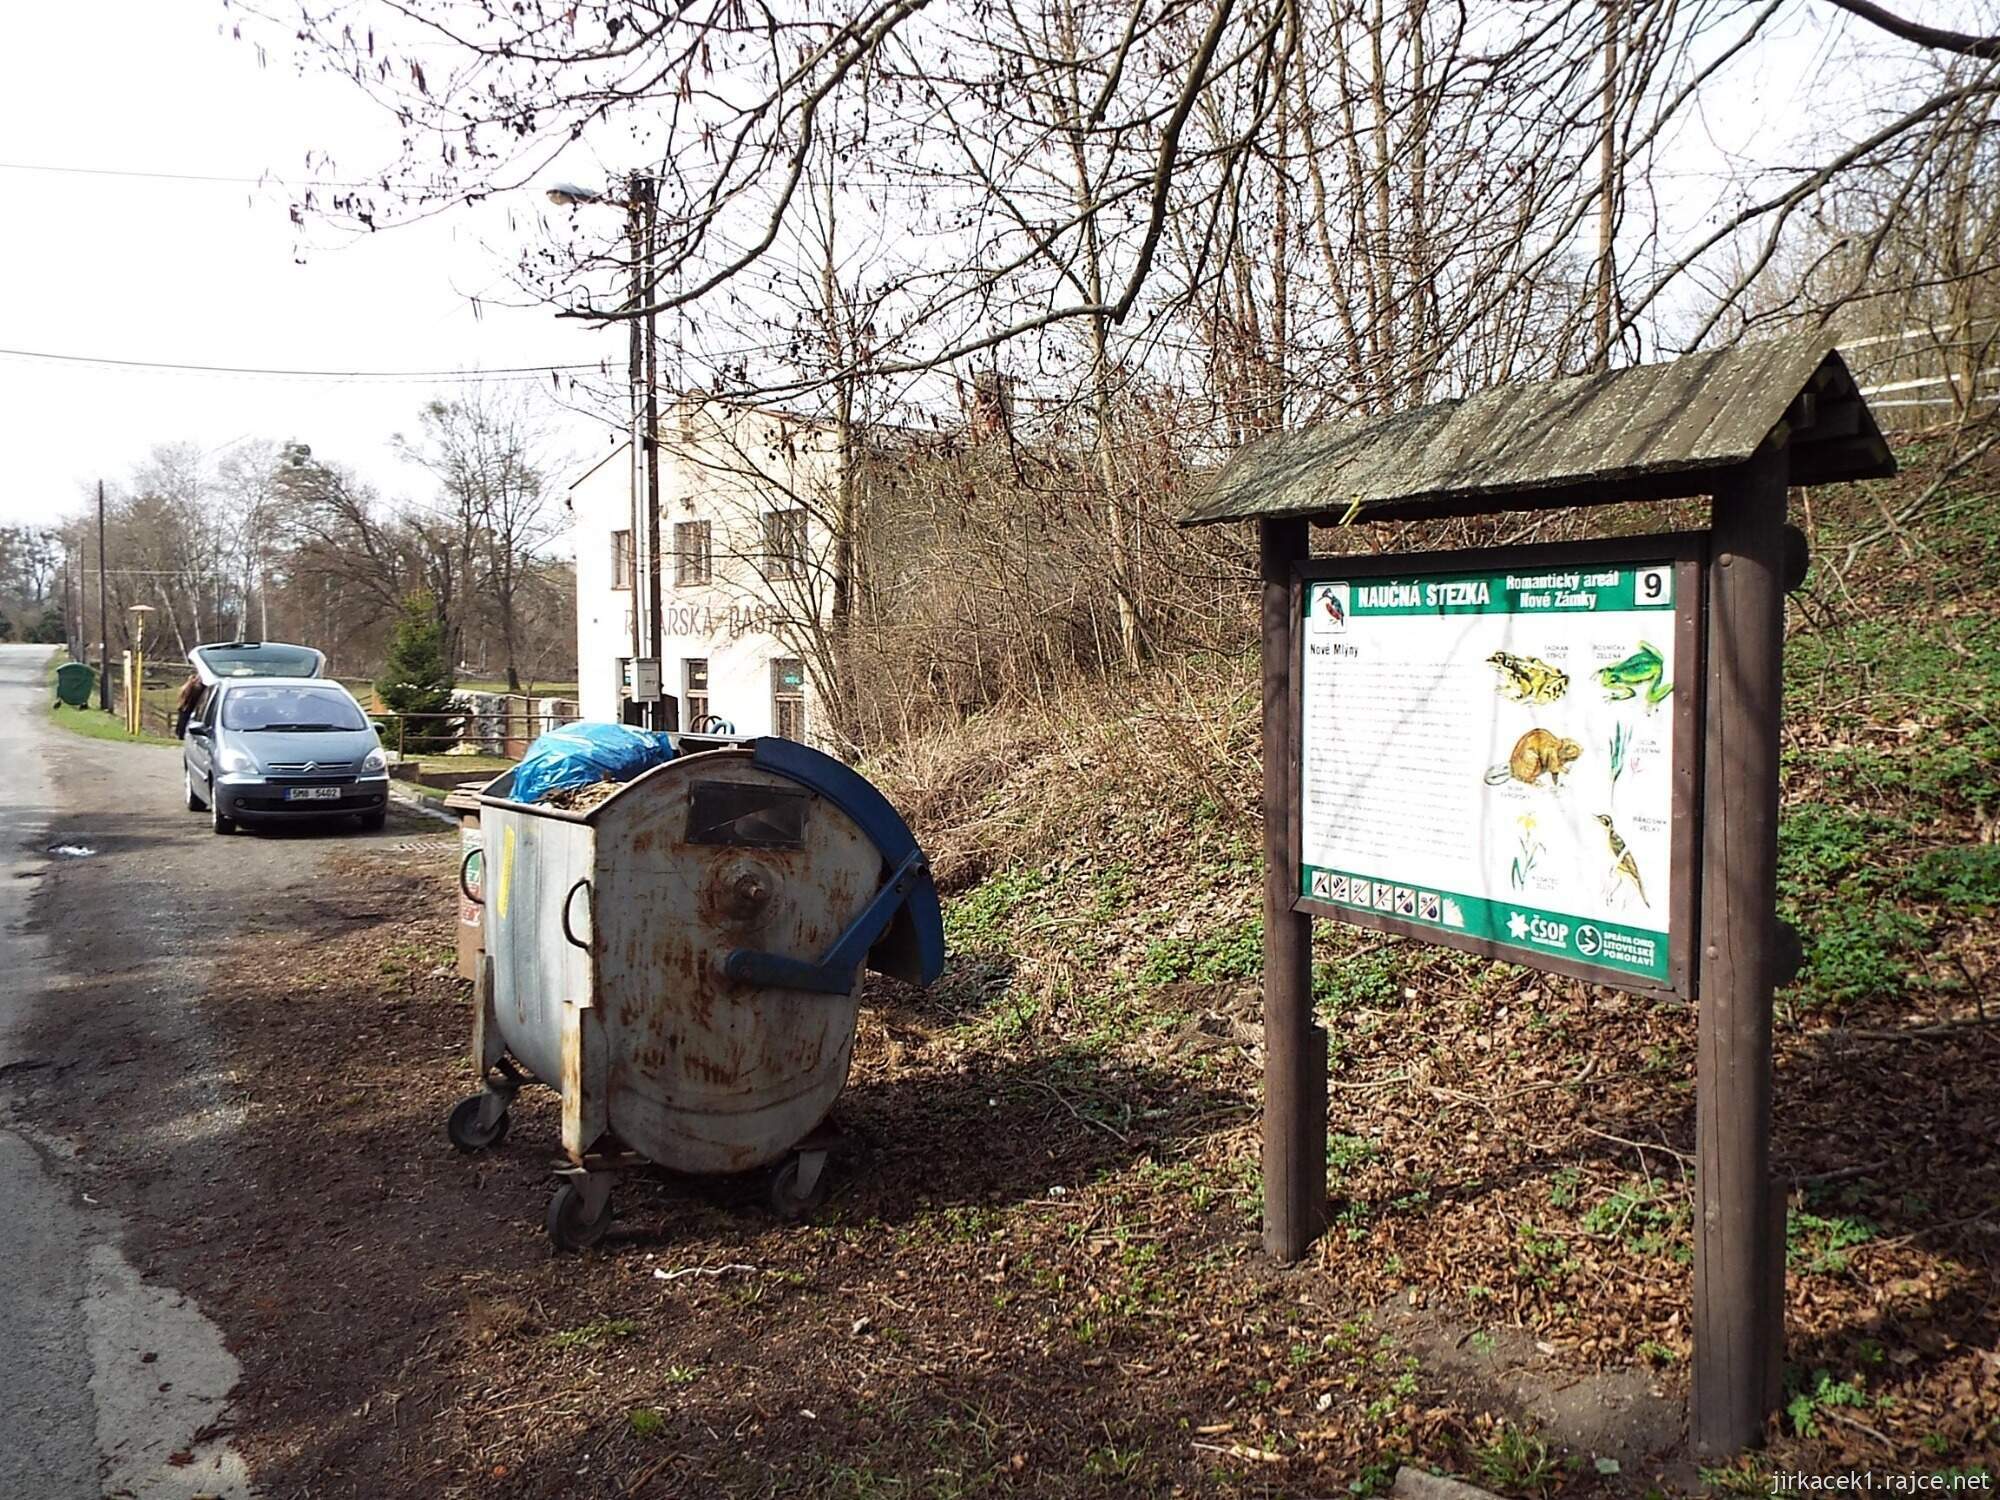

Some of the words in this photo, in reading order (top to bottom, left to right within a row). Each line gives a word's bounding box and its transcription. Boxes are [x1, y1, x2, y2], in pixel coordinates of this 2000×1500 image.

[1506, 571, 1580, 591] Romantický
[1583, 570, 1620, 588] areál
[1644, 572, 1662, 599] 9
[1358, 579, 1421, 608] NAUČNÁ
[1426, 581, 1490, 607] STEZKA
[1520, 591, 1551, 608] Nové
[1554, 590, 1597, 610] Zámky
[1310, 642, 1331, 655] Nové
[1333, 642, 1359, 658] Mlýny
[1530, 914, 1569, 942] ČSOP
